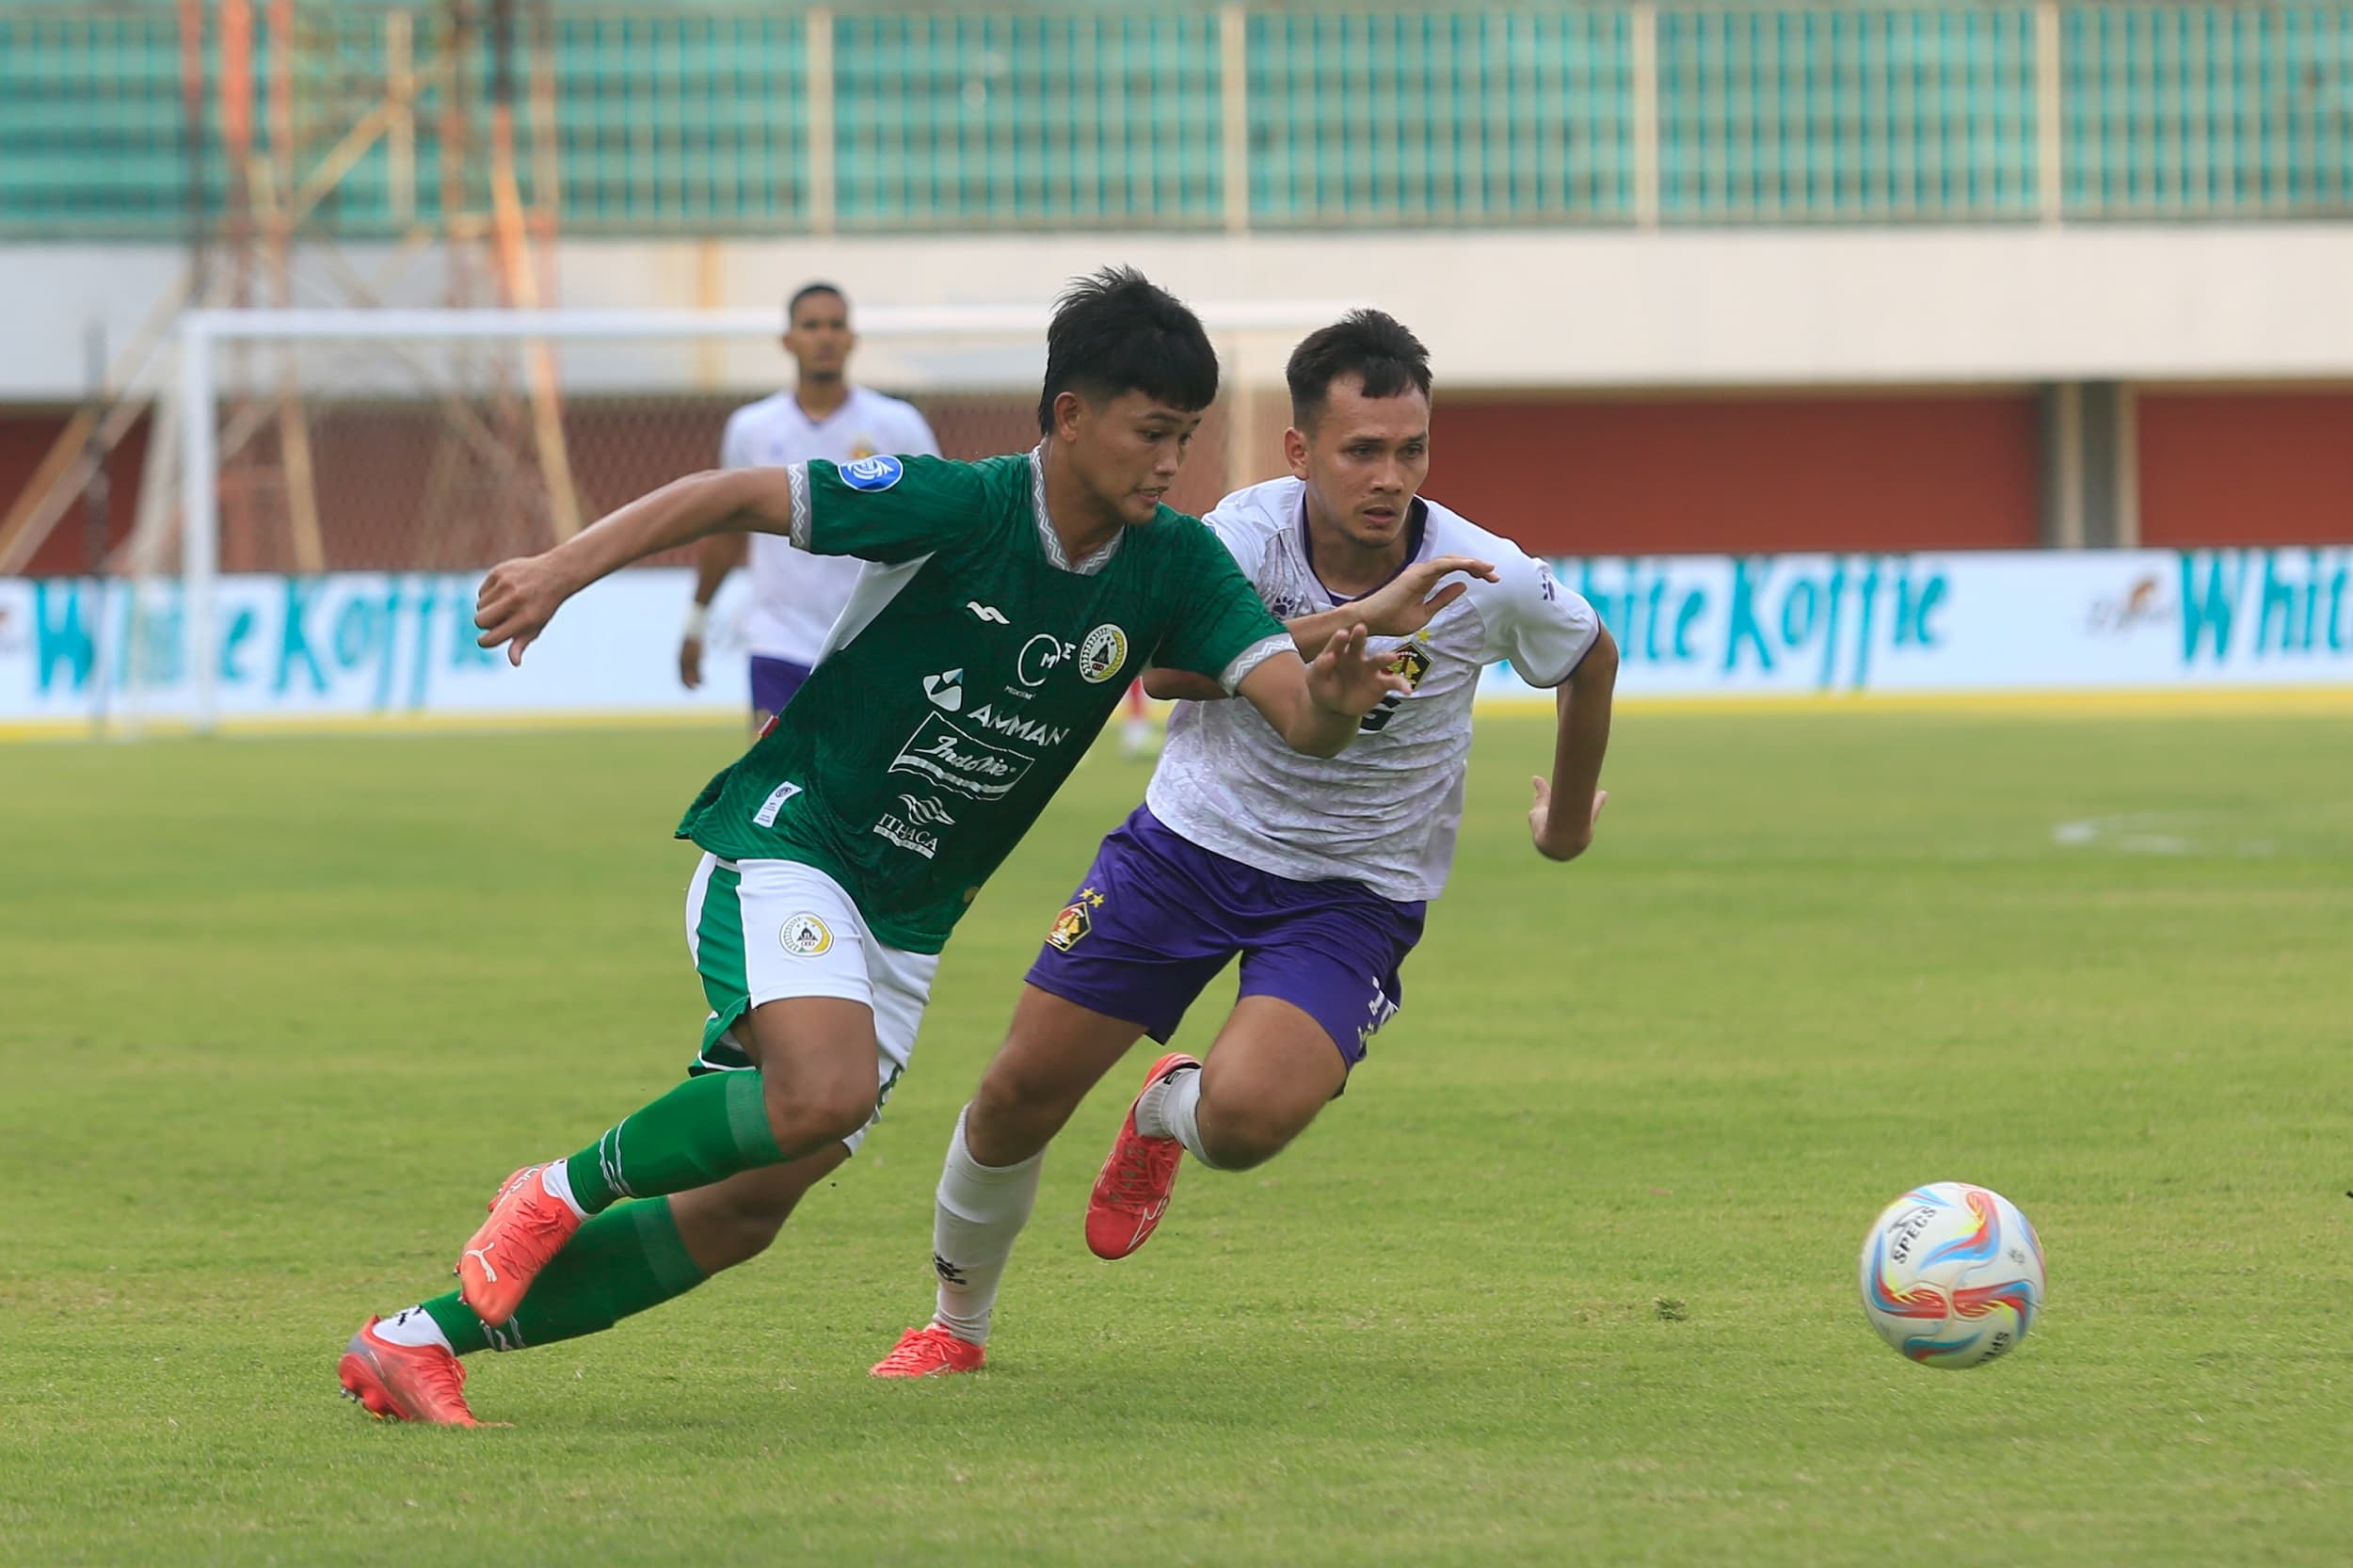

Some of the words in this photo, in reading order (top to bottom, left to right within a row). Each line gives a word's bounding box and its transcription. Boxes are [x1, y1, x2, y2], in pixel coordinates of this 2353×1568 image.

[1555, 553, 1707, 661] hite
[1724, 553, 1948, 692] Koffie
[967, 703, 1071, 746] AMMAN
[878, 813, 938, 853] ITHACA
[1893, 1207, 1936, 1264] SPECS
